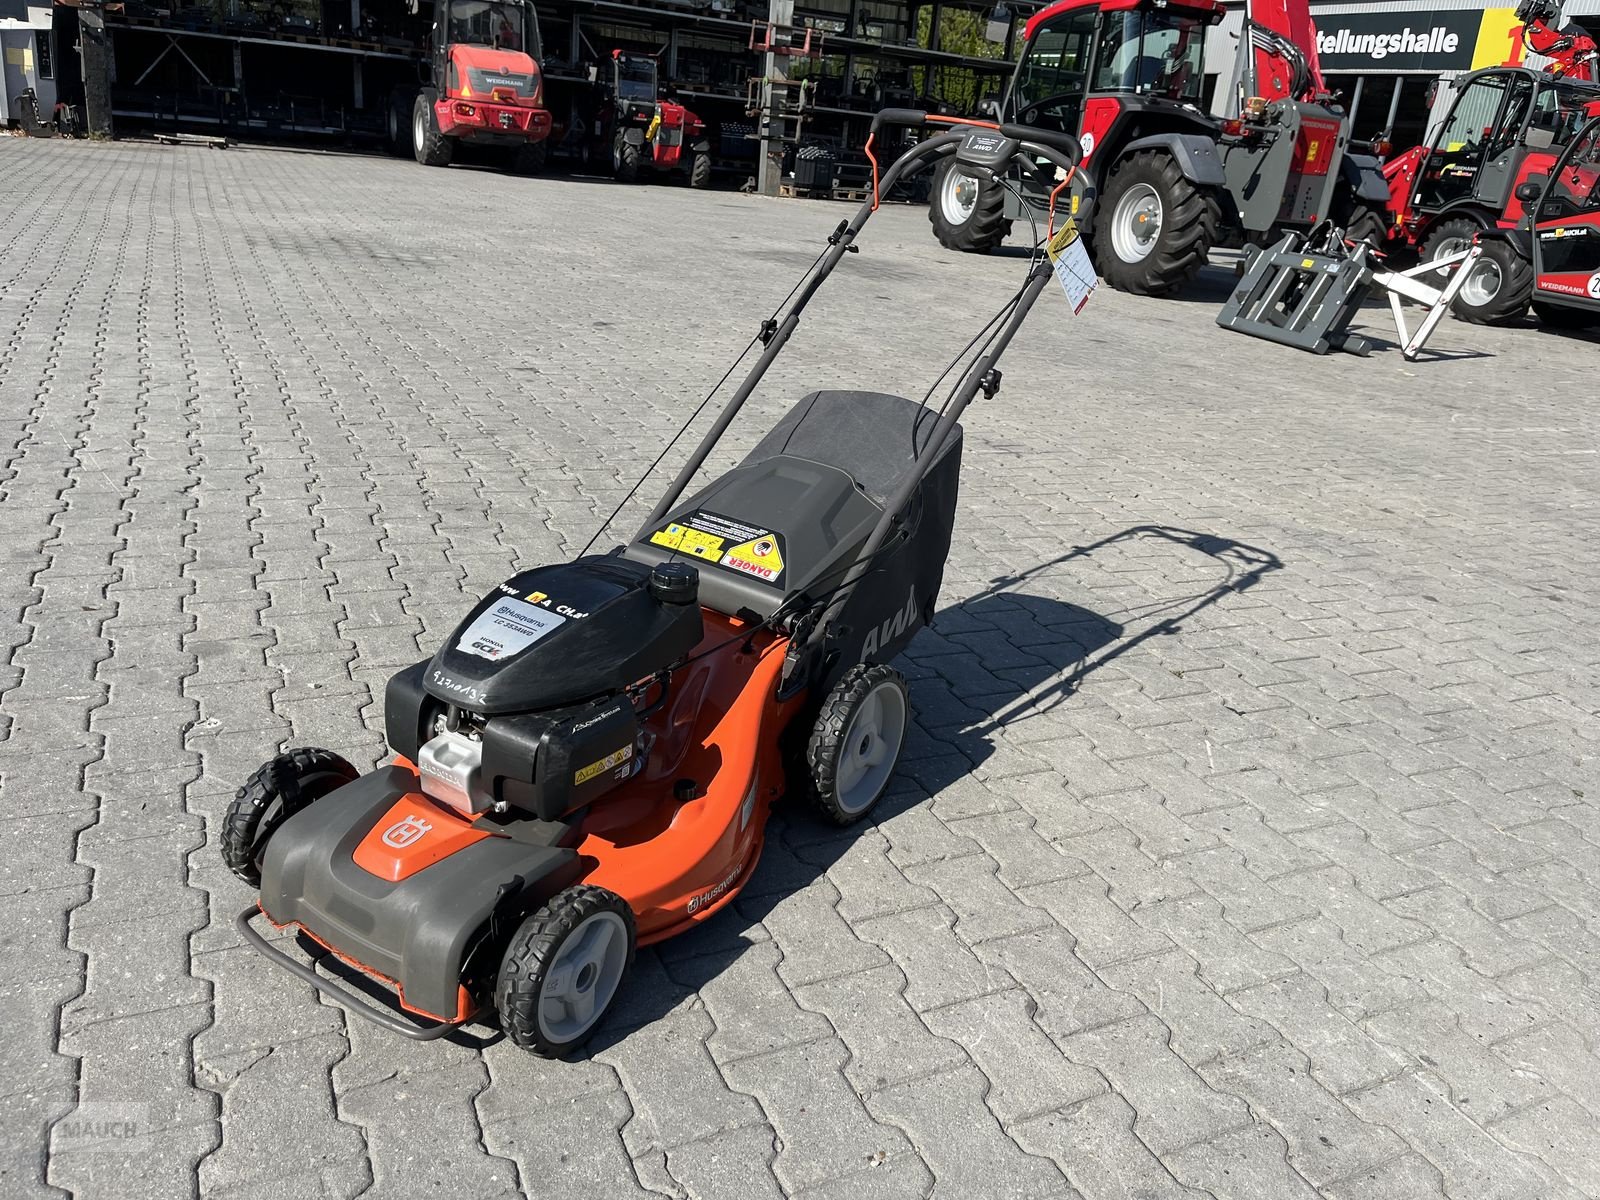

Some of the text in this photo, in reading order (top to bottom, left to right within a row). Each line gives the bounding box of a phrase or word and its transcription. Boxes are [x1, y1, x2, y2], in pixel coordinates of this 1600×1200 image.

[1316, 27, 1459, 59] tellungshalle
[485, 77, 524, 87] WEIDEMANN
[972, 144, 993, 152] AWD
[1540, 281, 1585, 294] WEIDEMANN
[728, 556, 773, 578] DANGER
[494, 618, 535, 637] LC 353AWD
[505, 608, 546, 629] Husqvarna
[860, 584, 918, 664] AWD
[480, 636, 505, 649] HONDA
[420, 760, 464, 788] HONDA
[699, 863, 743, 906] Husqvarna
